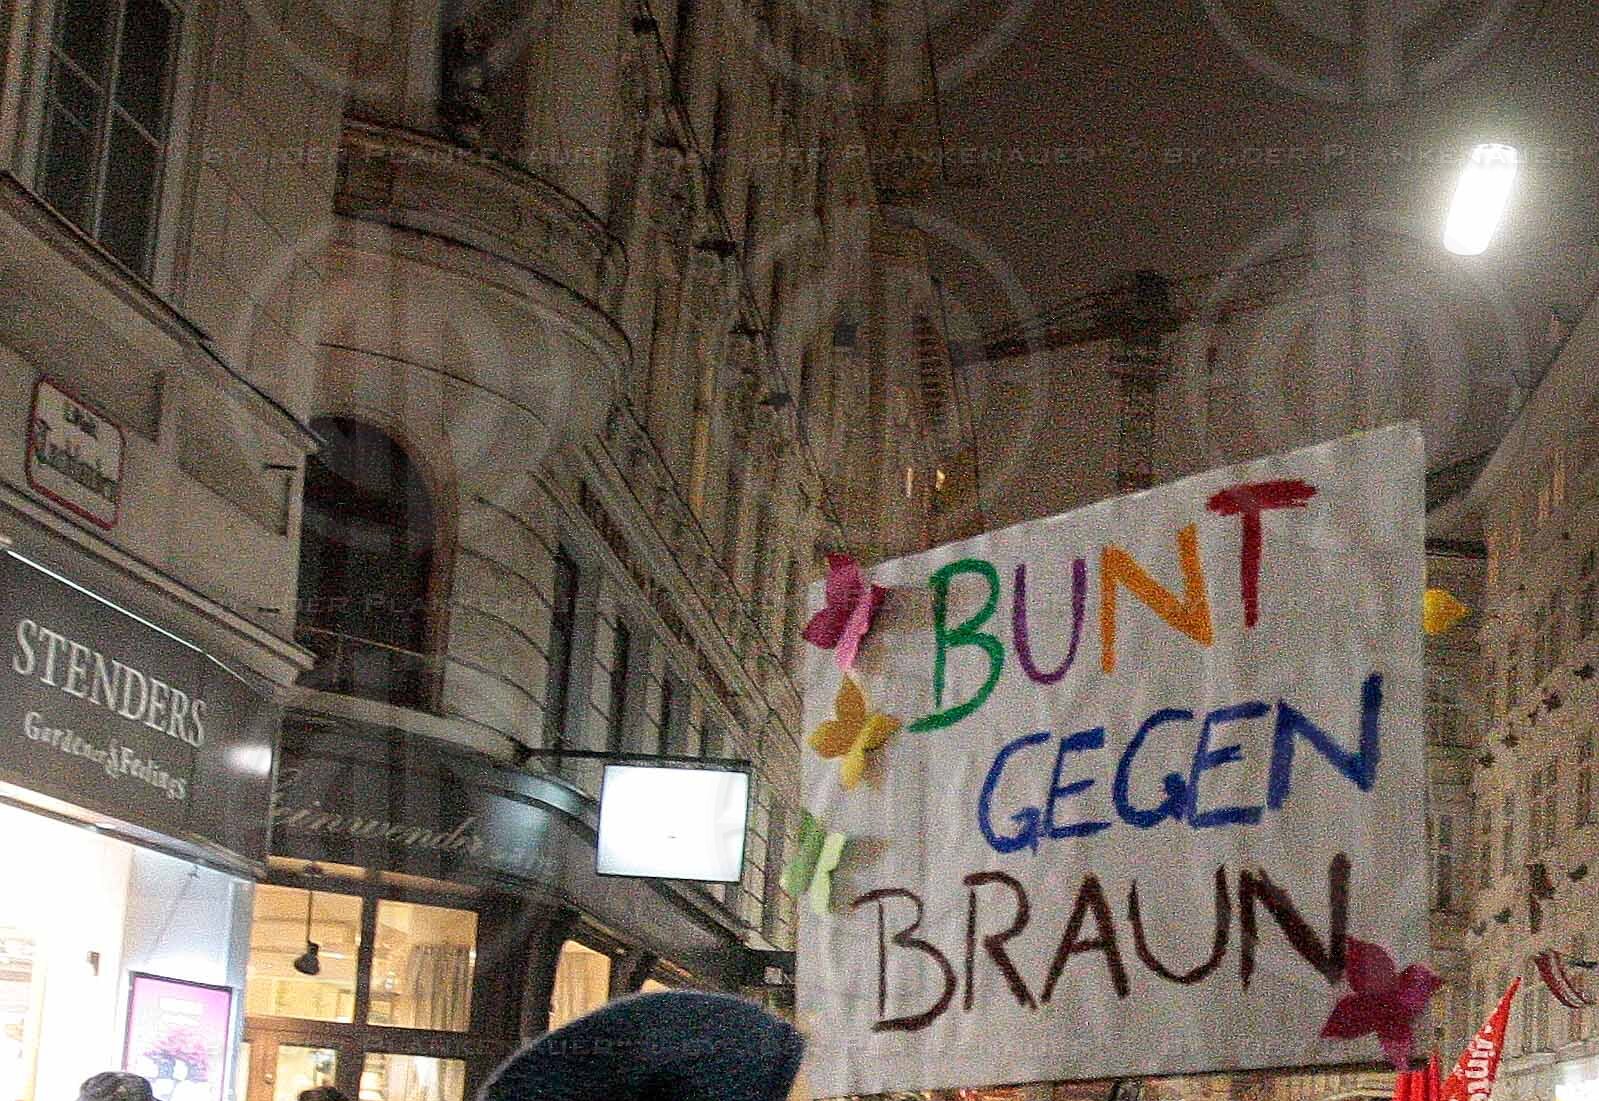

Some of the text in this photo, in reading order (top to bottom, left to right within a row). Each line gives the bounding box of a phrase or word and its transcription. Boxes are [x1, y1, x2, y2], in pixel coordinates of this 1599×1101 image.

[13, 618, 207, 748] STENDERS
[908, 478, 1318, 733] BUNT
[977, 672, 1382, 855] GEGEN
[850, 852, 1352, 1034] BRAUN
